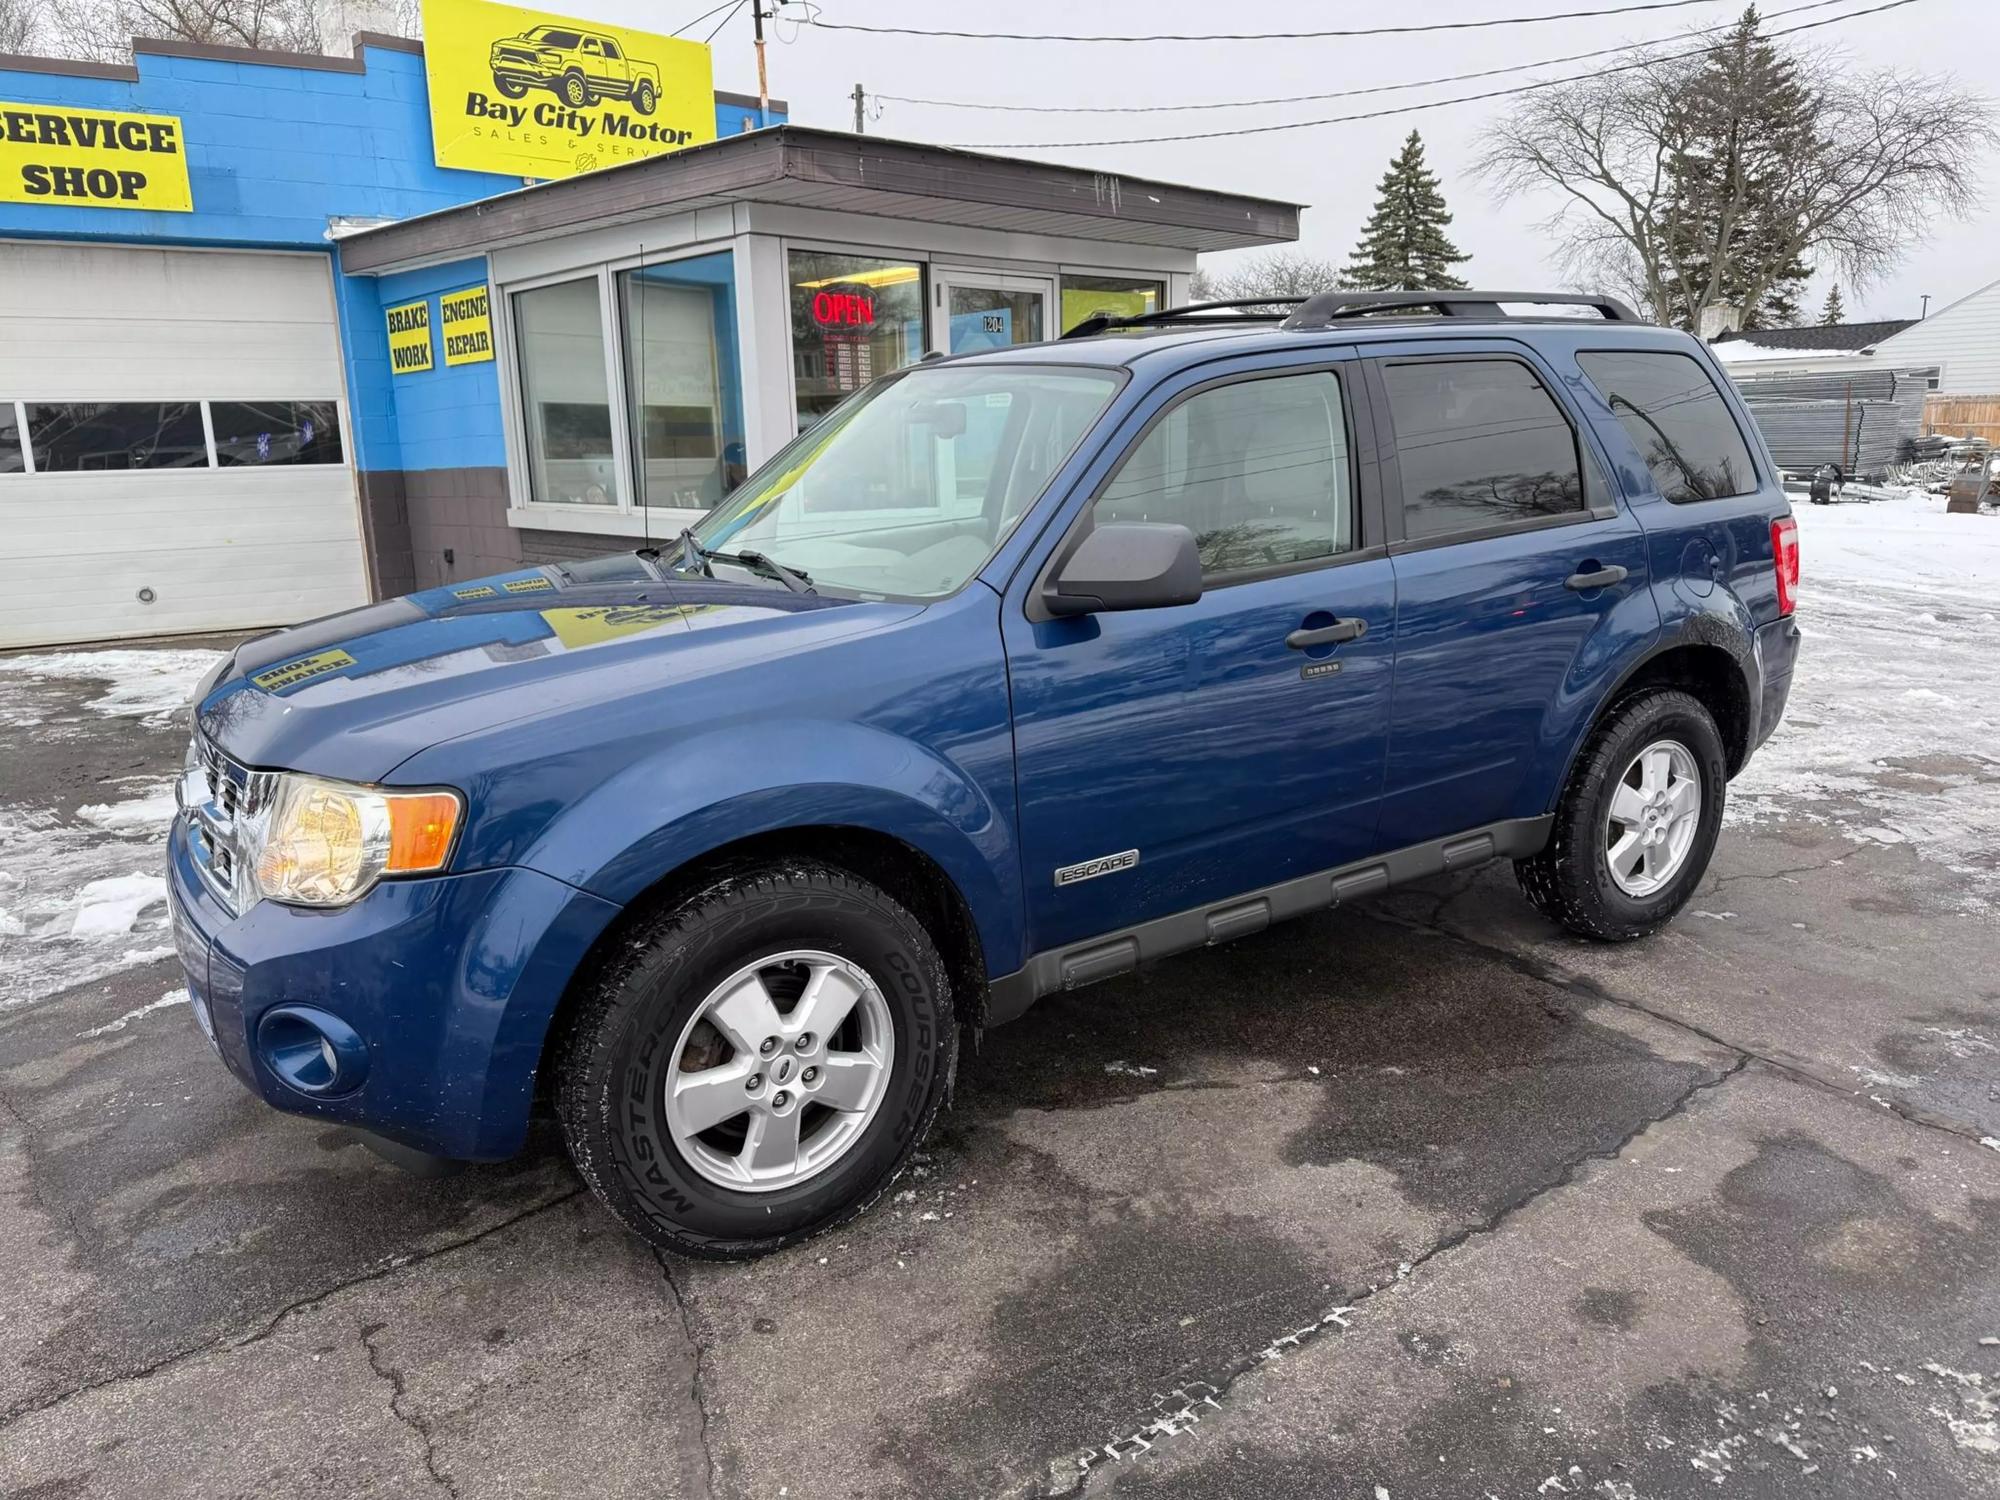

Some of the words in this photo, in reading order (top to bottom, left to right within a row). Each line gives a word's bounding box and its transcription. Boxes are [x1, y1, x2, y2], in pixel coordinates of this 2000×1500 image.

[0, 111, 177, 153] ERVICE
[465, 92, 528, 127] Bay
[534, 103, 596, 138] City
[601, 112, 693, 146] Motor
[473, 126, 548, 145] SALES
[567, 138, 577, 149] &
[597, 143, 660, 157] SERV
[21, 164, 147, 200] SHOP
[388, 305, 428, 334] BRAKE
[442, 295, 487, 324] ENGINE
[814, 291, 874, 326] OPEN
[983, 316, 1004, 333] 1204
[393, 343, 429, 369] WORK
[446, 330, 490, 357] REPAIR
[1062, 854, 1134, 882] ESCAPE
